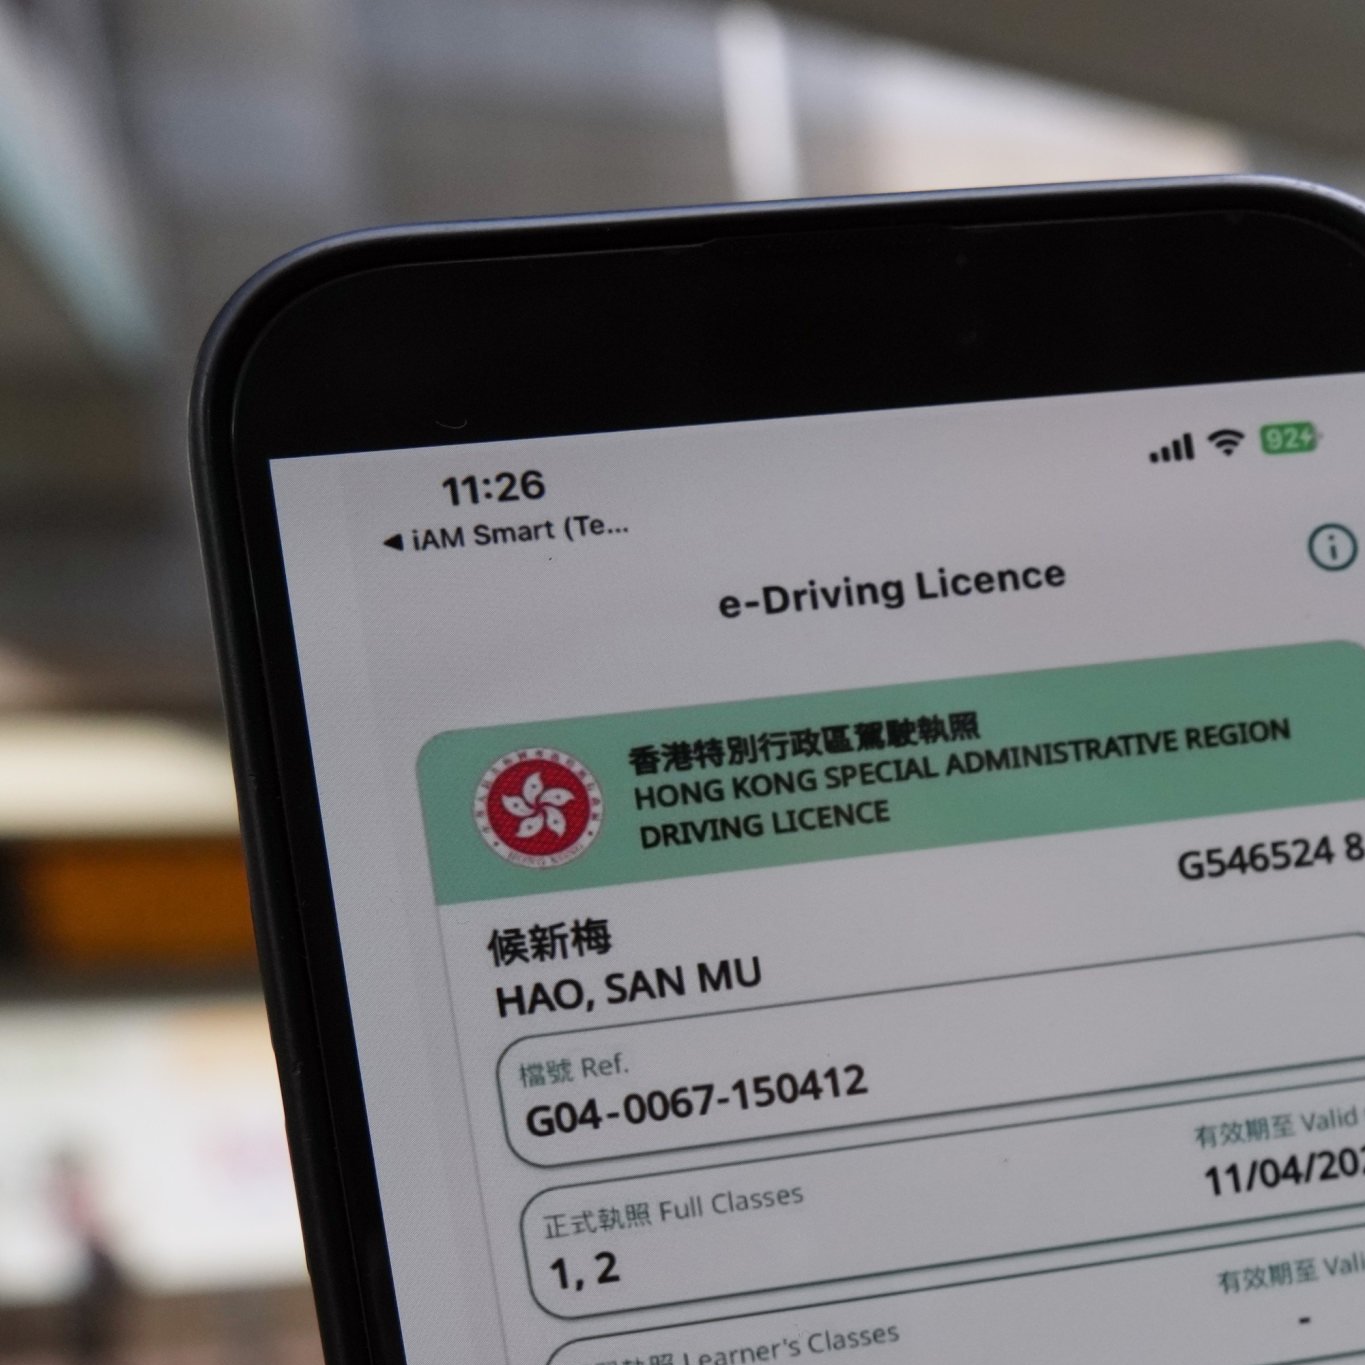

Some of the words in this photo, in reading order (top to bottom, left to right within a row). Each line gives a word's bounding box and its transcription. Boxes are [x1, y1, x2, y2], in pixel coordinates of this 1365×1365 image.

[441, 469, 546, 506] 11:26
[411, 526, 465, 551] iAM
[473, 520, 555, 546] Smart
[565, 515, 629, 542] (Te...
[719, 575, 904, 621] e-Driving
[915, 561, 1067, 600] Licence
[628, 711, 981, 776] 香港特別行政區駕駛執照
[633, 778, 726, 811] HONG
[732, 769, 819, 800] KONG
[824, 756, 940, 789] SPECIAL
[944, 729, 1180, 777] ADMINISTRATIVE
[1184, 717, 1292, 751] REGION
[640, 814, 764, 850] DRIVING
[771, 799, 891, 835] LICENCE
[1177, 837, 1335, 881] G546524
[1343, 832, 1365, 862] 8
[487, 917, 612, 967] 候新梅
[496, 978, 595, 1018] HAO,
[605, 965, 685, 1004] SAN
[697, 956, 762, 993] MU
[519, 1058, 574, 1088] 檔號
[581, 1052, 629, 1078] Ref.
[525, 1063, 868, 1137] G04-0067-150412
[1193, 1113, 1296, 1149] 有效期至
[1300, 1105, 1360, 1133] Valid
[543, 1202, 653, 1240] 正式執照
[659, 1196, 703, 1221] Full
[711, 1184, 805, 1215] Classes
[550, 1257, 584, 1291] 1,
[594, 1250, 621, 1284] 2
[1217, 1258, 1319, 1295] 有效期至
[807, 1324, 900, 1355] Classes
